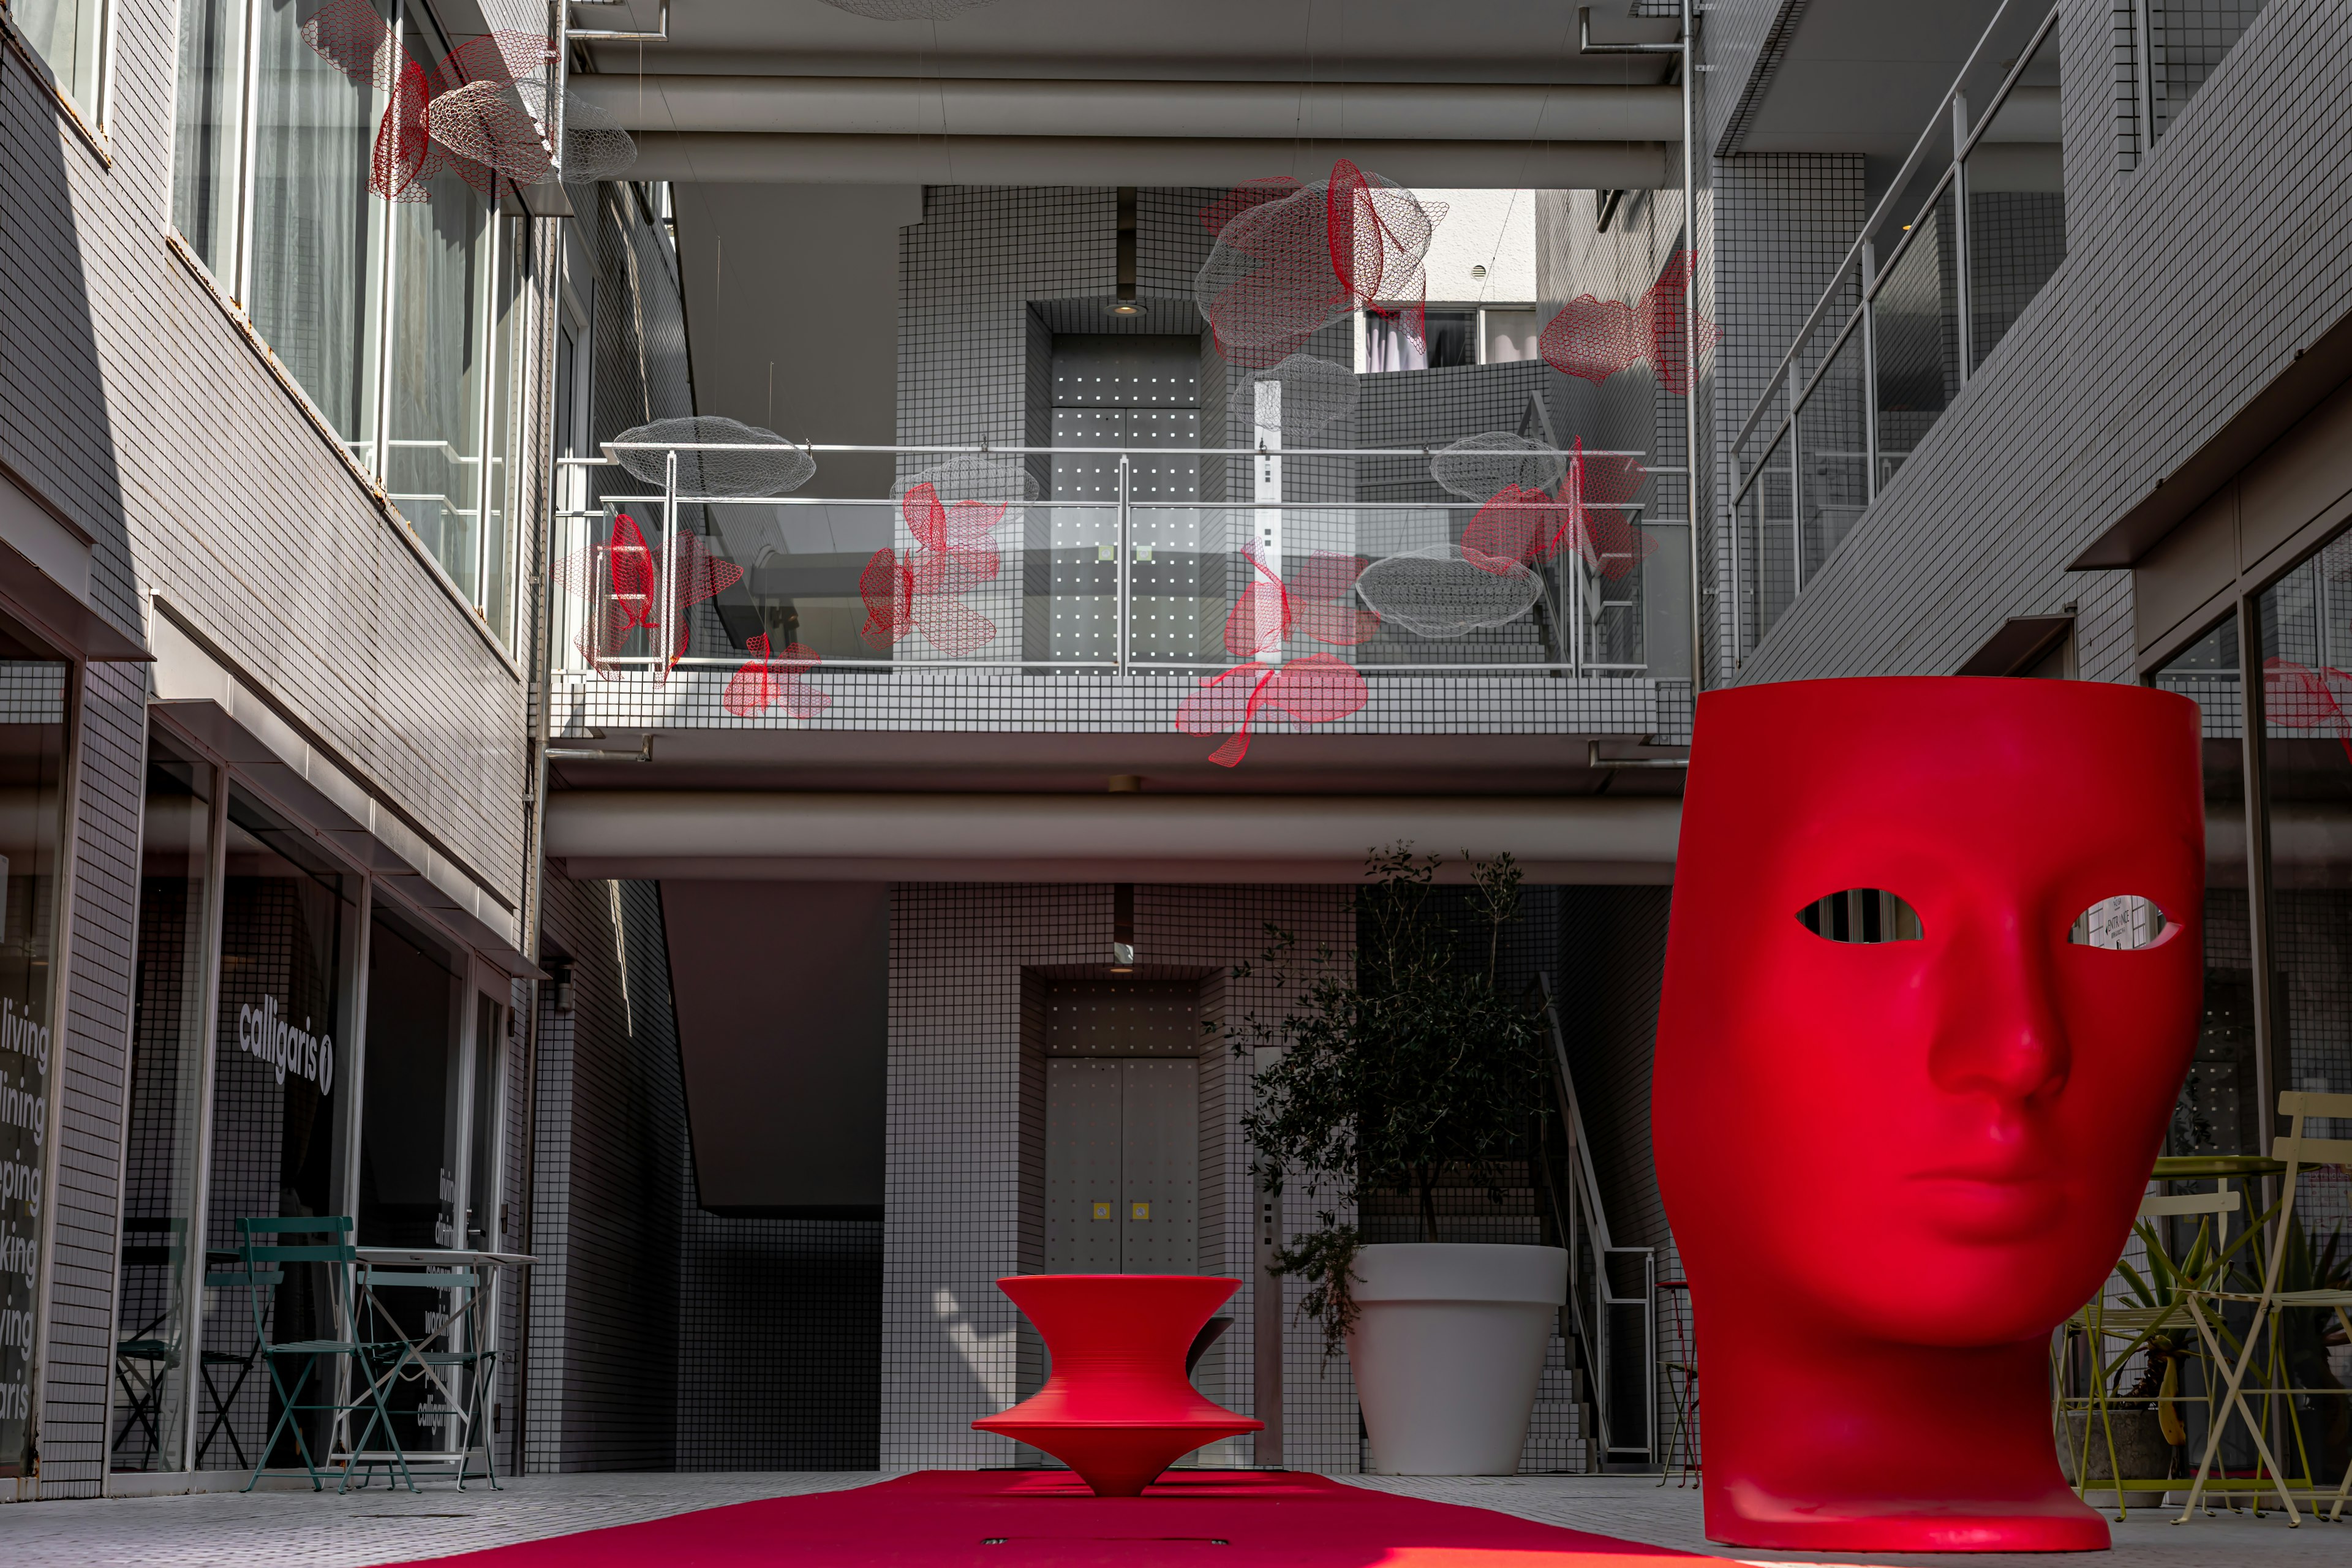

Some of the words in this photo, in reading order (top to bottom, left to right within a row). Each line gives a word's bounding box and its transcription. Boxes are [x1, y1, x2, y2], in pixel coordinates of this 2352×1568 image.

[2108, 910, 2129, 932] ENTRANCE
[1, 997, 49, 1076] living
[239, 993, 317, 1085] calligaris
[0, 1070, 45, 1146] ining
[0, 1148, 41, 1217] ping
[439, 1168, 454, 1204] livin
[435, 1213, 453, 1248] dinin
